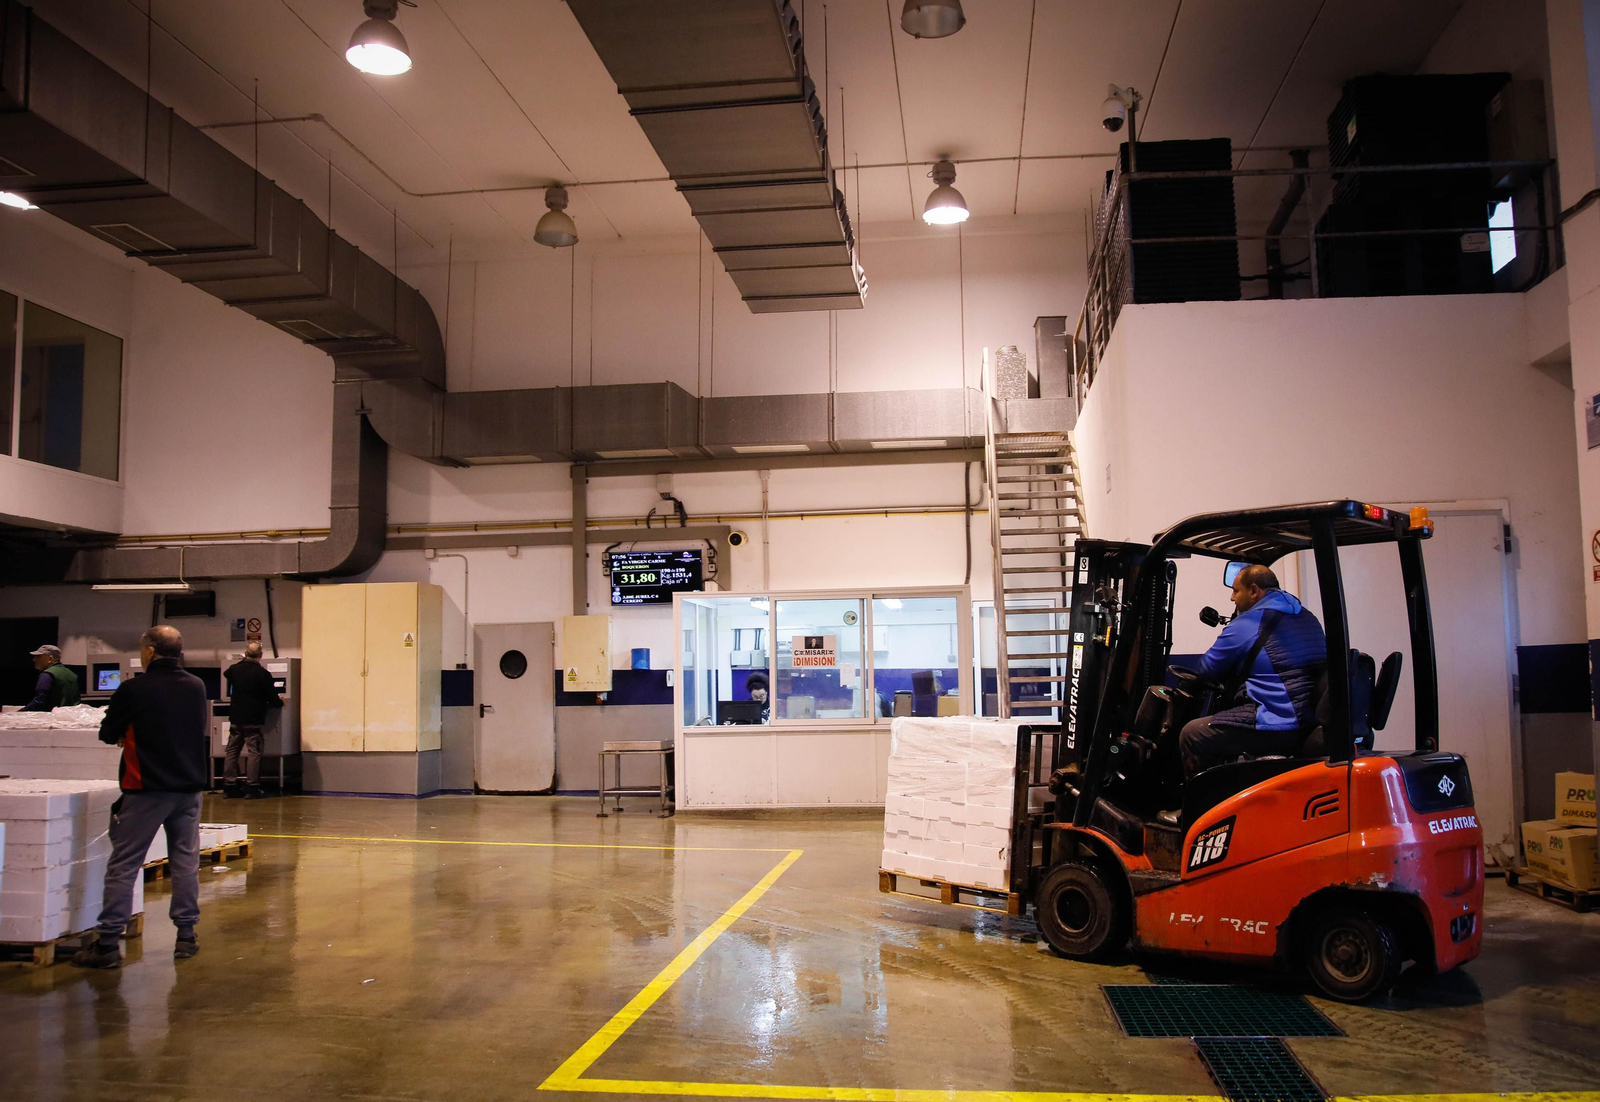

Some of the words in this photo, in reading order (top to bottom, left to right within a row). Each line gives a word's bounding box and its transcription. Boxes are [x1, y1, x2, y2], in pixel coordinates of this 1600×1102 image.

[620, 573, 656, 584] 31,80
[1067, 668, 1080, 750] ELEVATRAC
[1428, 815, 1478, 835] ELEVATRAC
[1190, 832, 1227, 867] A18
